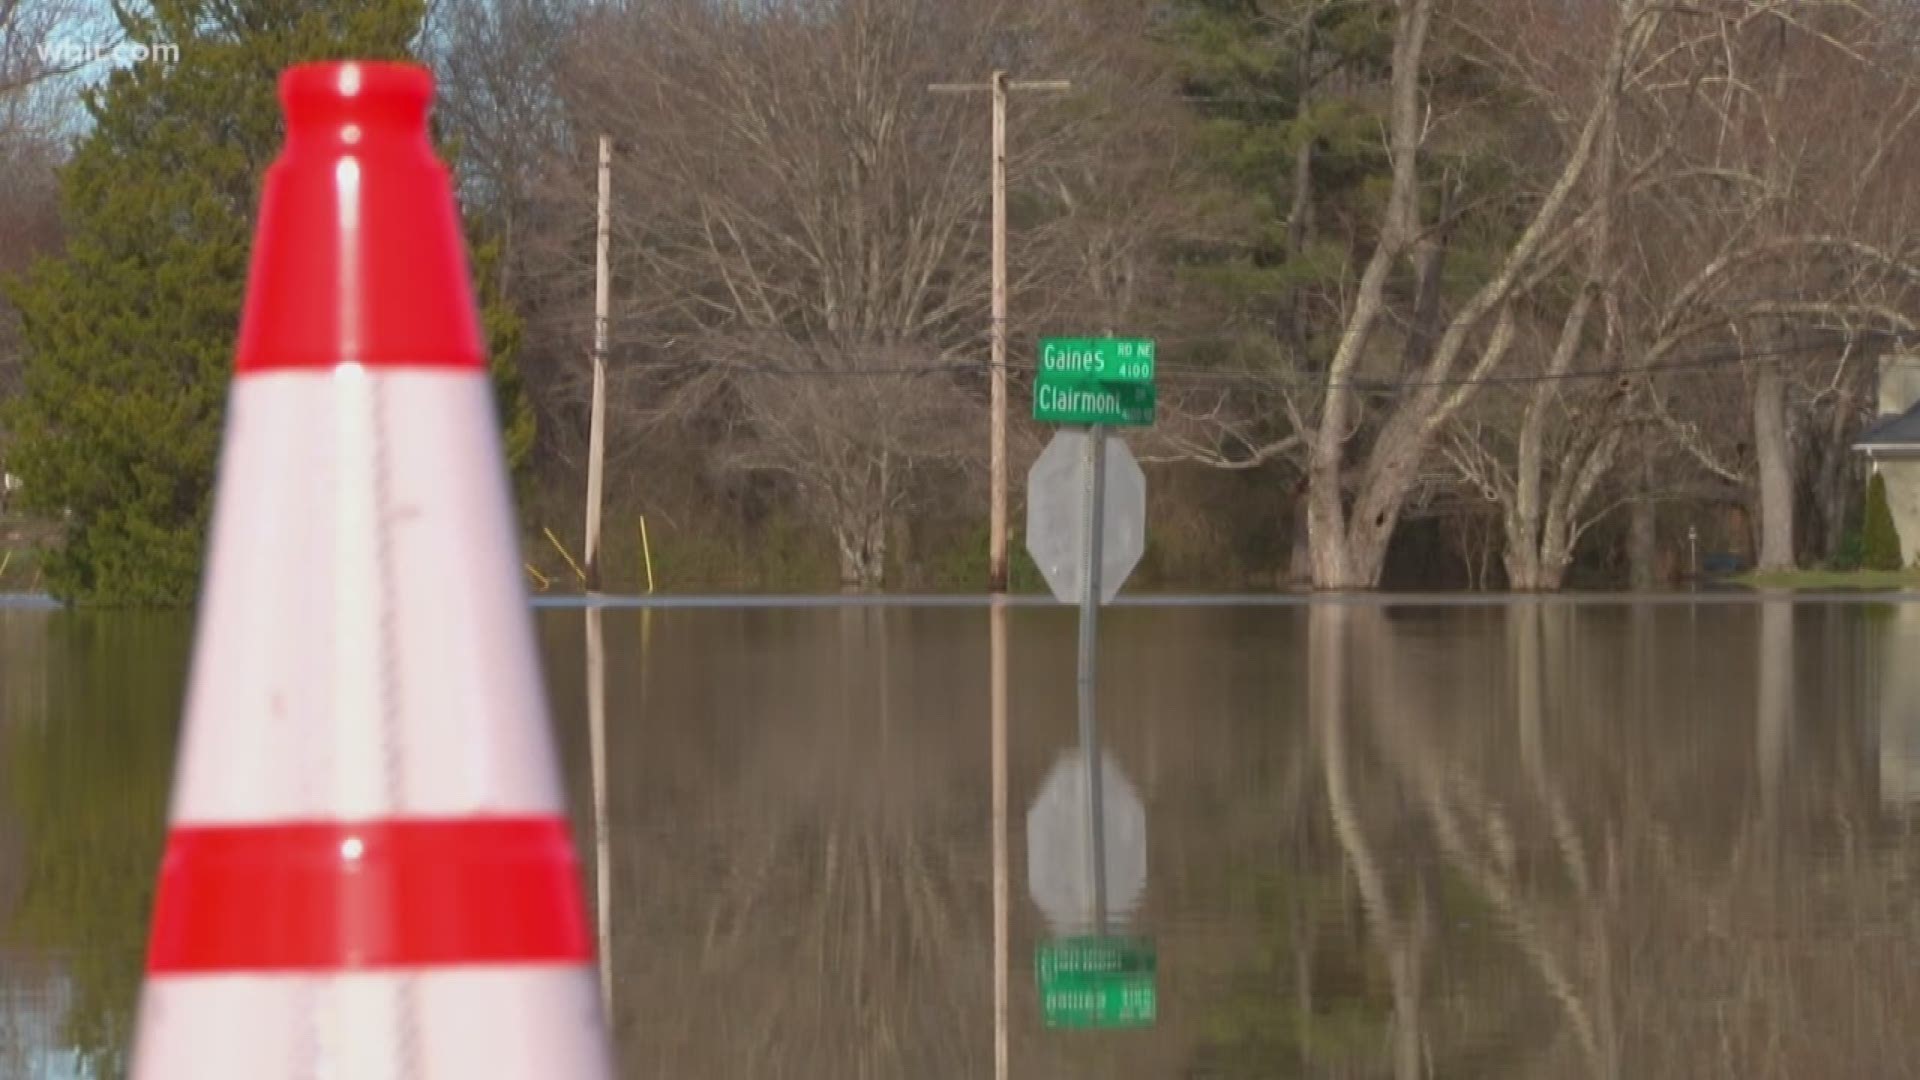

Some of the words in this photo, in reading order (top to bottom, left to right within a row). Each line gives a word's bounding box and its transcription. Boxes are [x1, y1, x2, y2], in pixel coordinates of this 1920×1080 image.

[1044, 342, 1105, 371] Gaines
[1117, 342, 1132, 356] RD
[1137, 342, 1151, 357] NE
[1118, 363, 1149, 378] 4100
